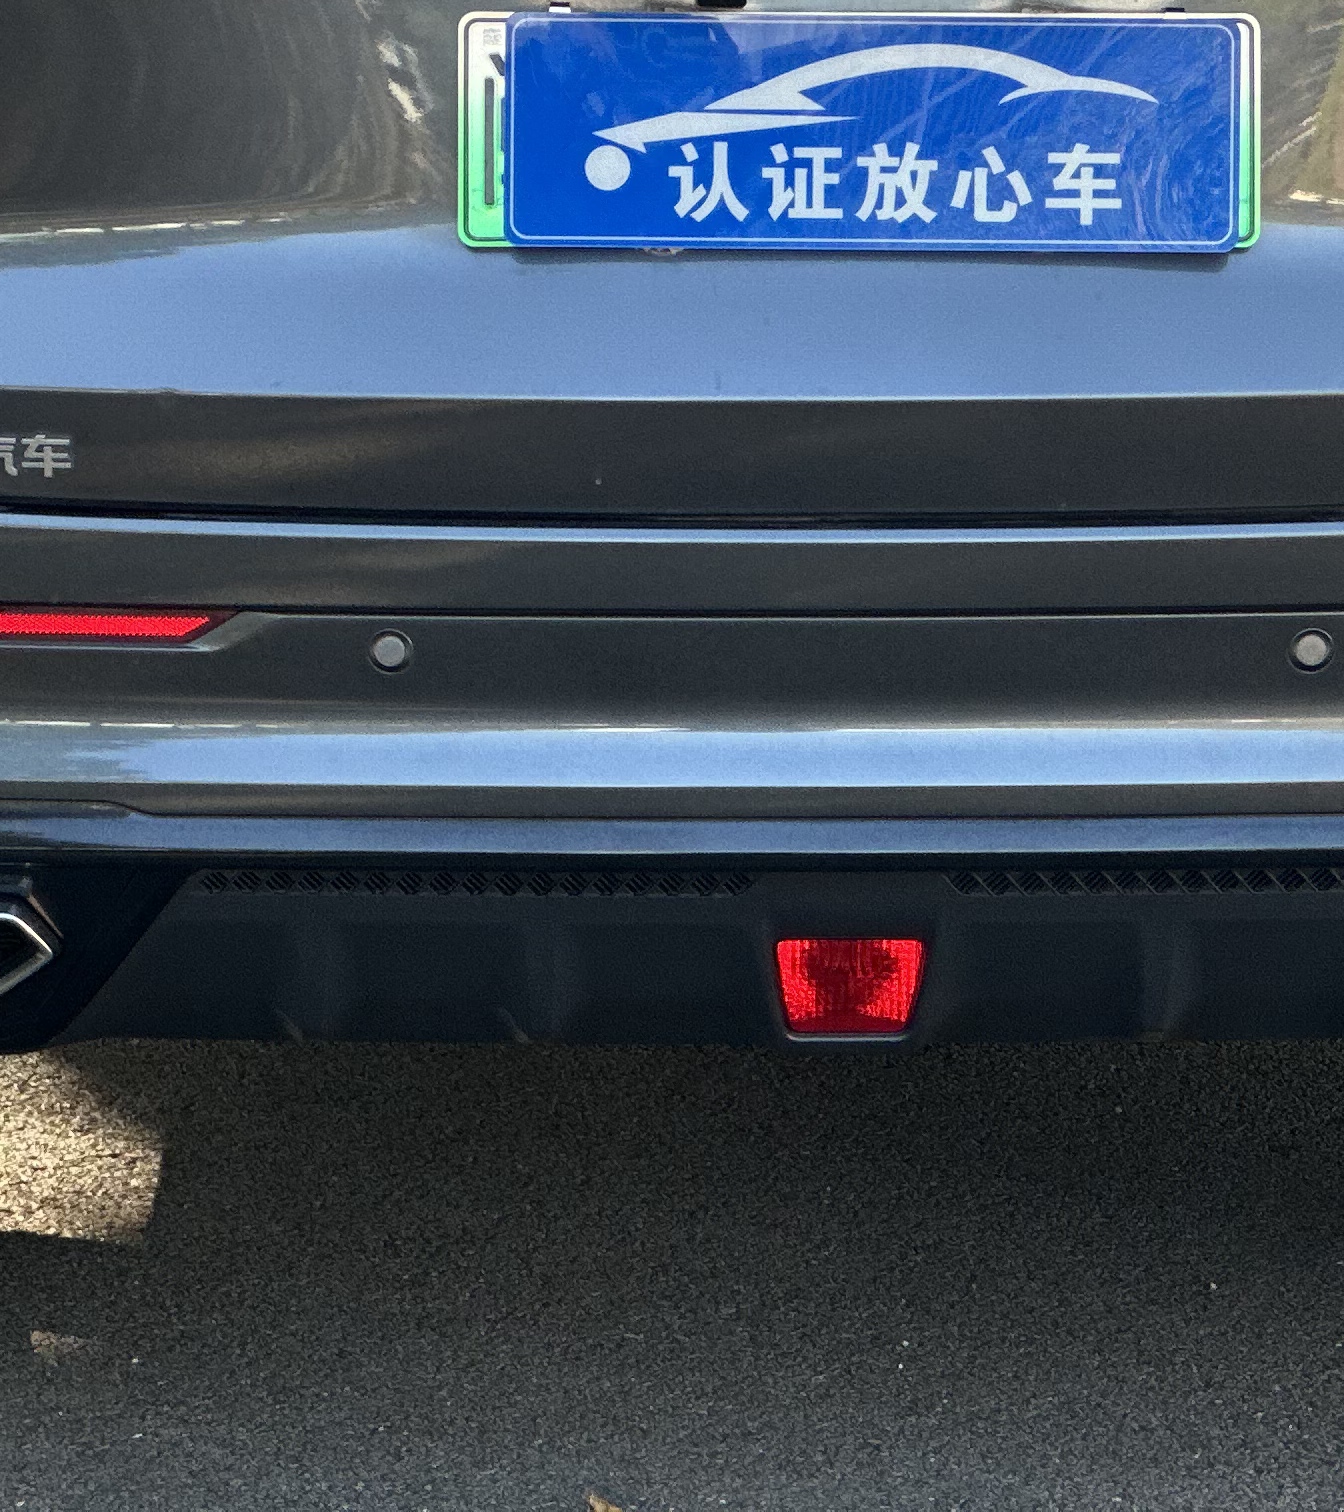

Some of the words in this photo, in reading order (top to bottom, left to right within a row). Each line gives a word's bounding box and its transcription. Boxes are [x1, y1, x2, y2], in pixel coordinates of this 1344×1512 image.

[668, 141, 1123, 226] 认证放心车
